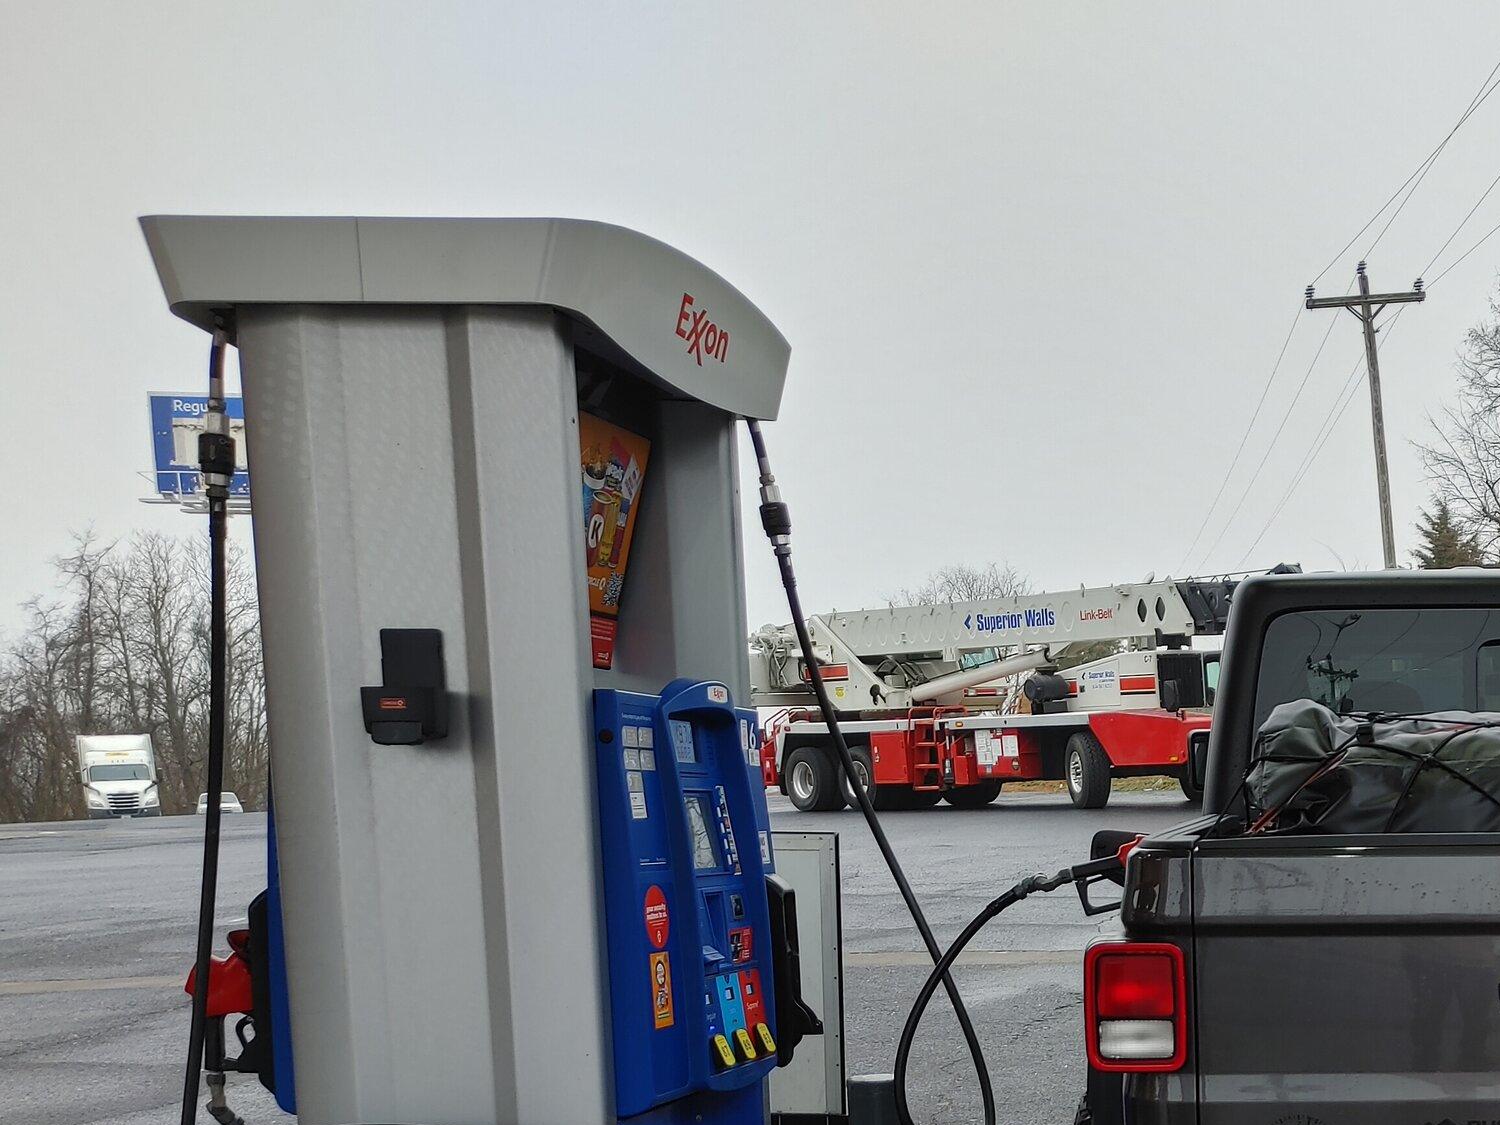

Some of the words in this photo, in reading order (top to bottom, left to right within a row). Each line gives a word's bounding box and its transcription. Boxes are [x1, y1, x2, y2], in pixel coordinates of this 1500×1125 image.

[675, 292, 729, 367] Exxon
[173, 399, 208, 415] Regu
[976, 611, 1023, 633] Superior
[1024, 608, 1055, 627] Walls
[1079, 607, 1113, 621] Link-Belt
[750, 722, 756, 749] 6
